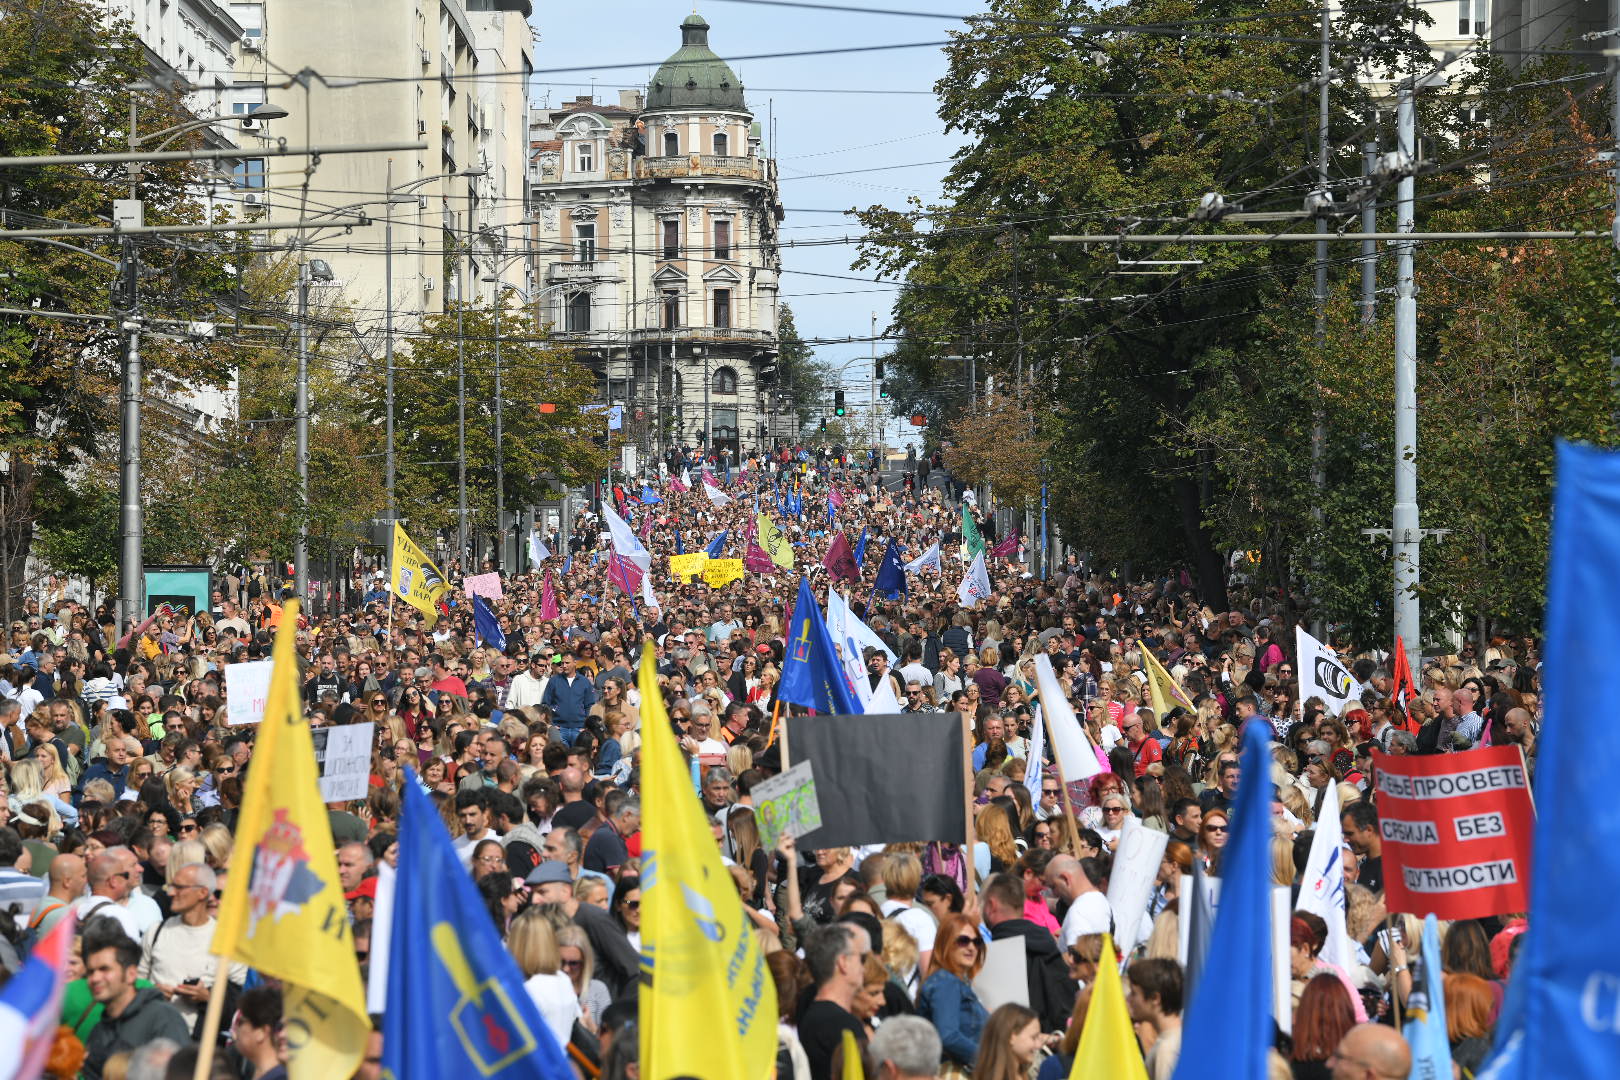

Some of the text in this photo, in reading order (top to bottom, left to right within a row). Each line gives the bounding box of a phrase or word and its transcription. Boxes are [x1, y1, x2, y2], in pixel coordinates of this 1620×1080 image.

[1413, 768, 1524, 796] ПРОСВЕТЕ
[1382, 815, 1502, 842] СРБИЈА БЕЗ
